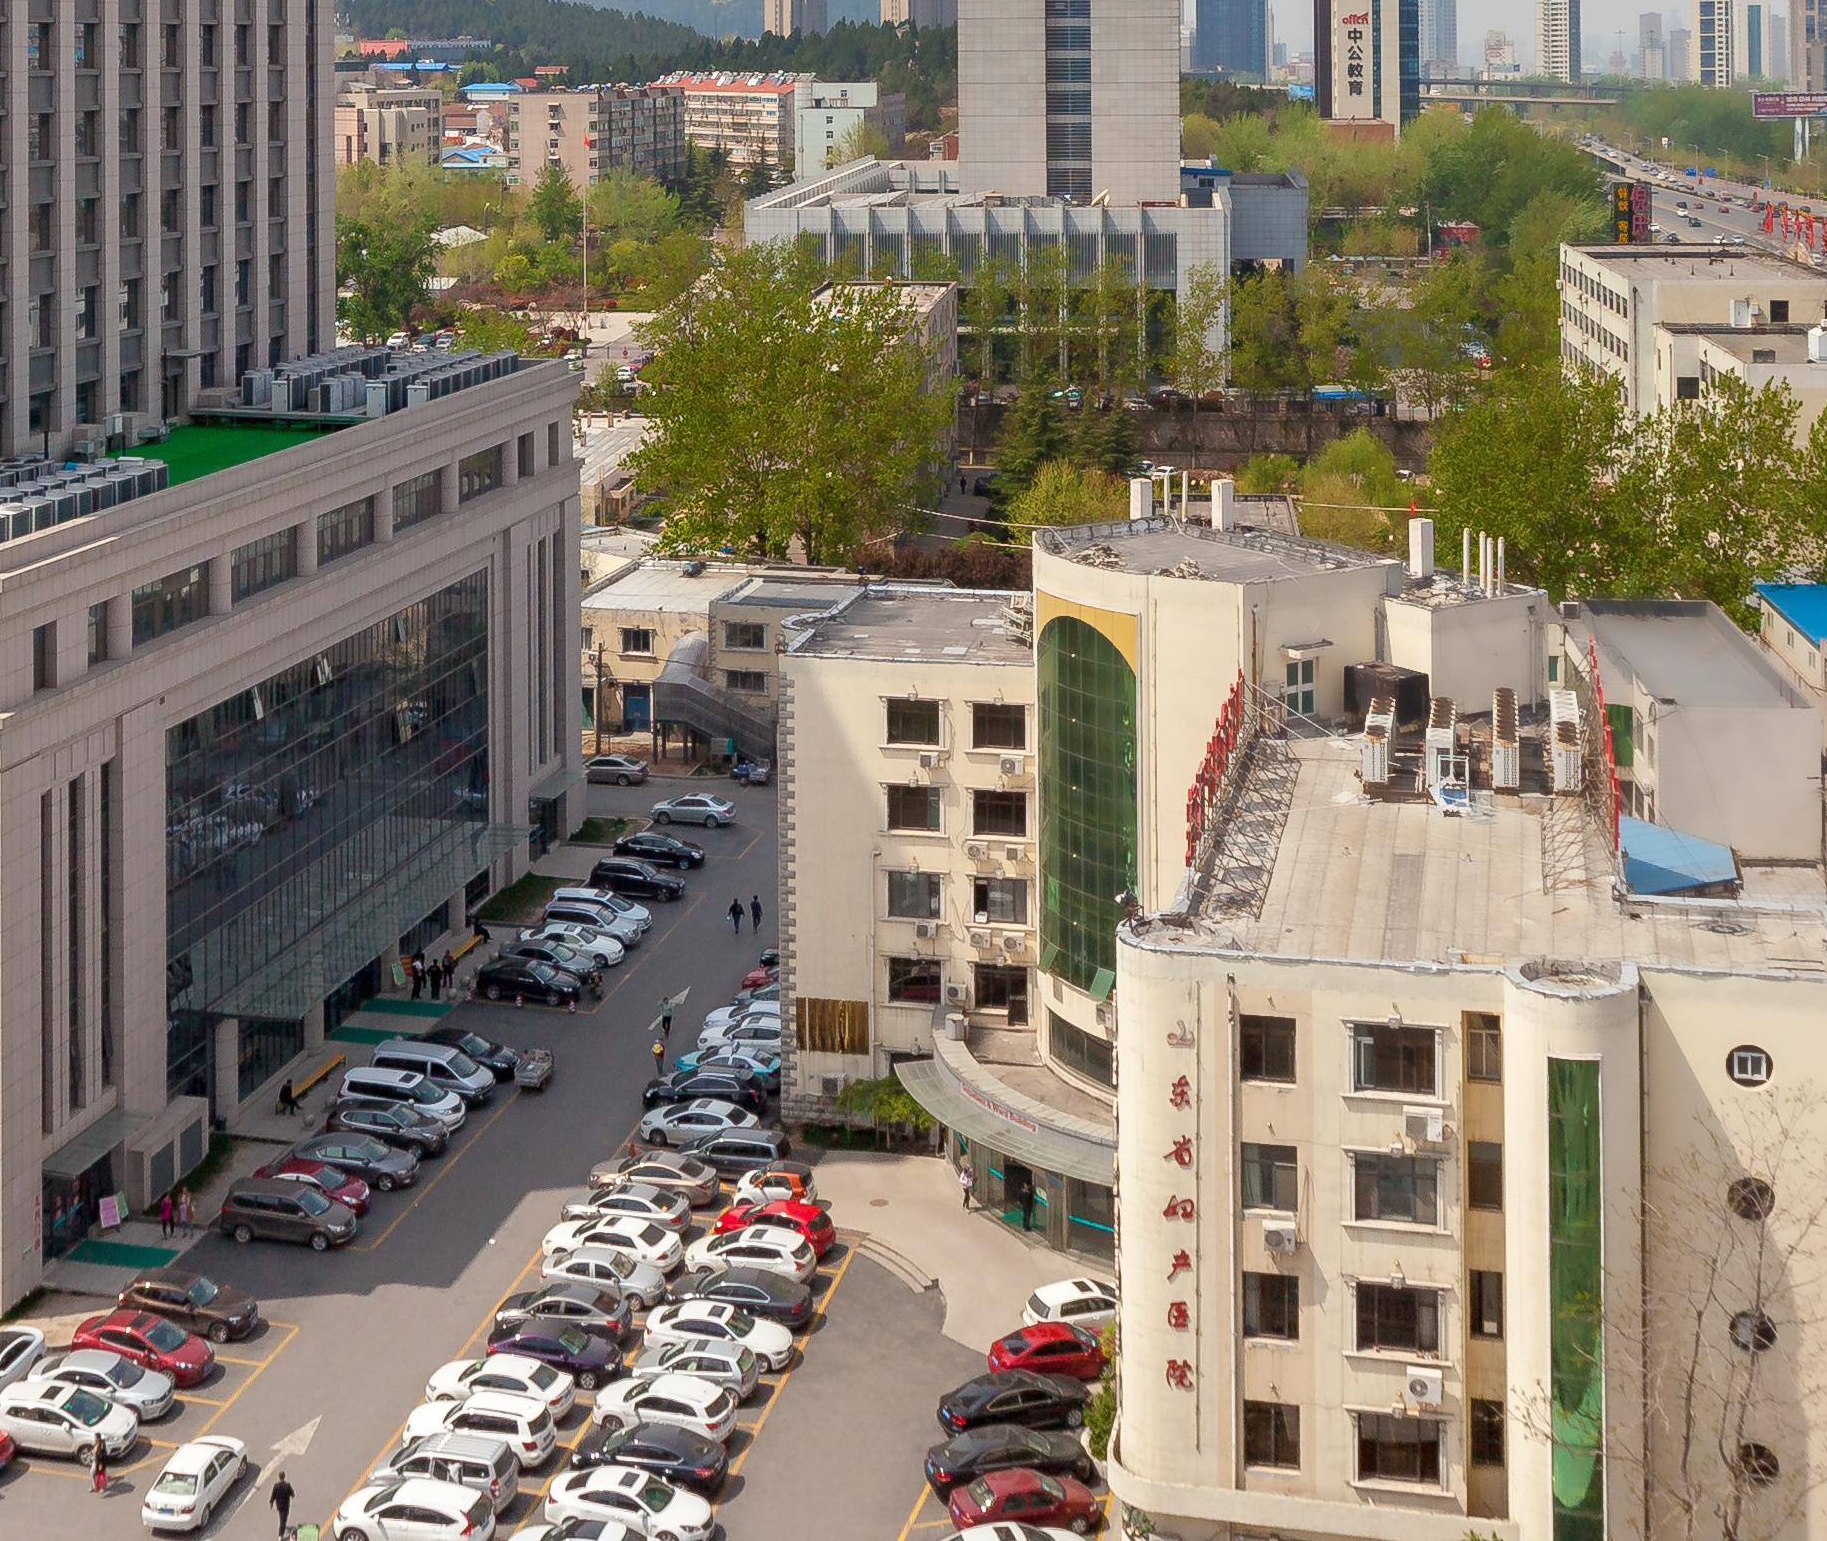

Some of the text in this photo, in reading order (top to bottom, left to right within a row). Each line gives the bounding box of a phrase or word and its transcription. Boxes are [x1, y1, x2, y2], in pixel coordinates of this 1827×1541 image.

[1347, 27, 1363, 97] 中公教育
[1162, 1019, 1195, 1391] 山东省妇产医院
